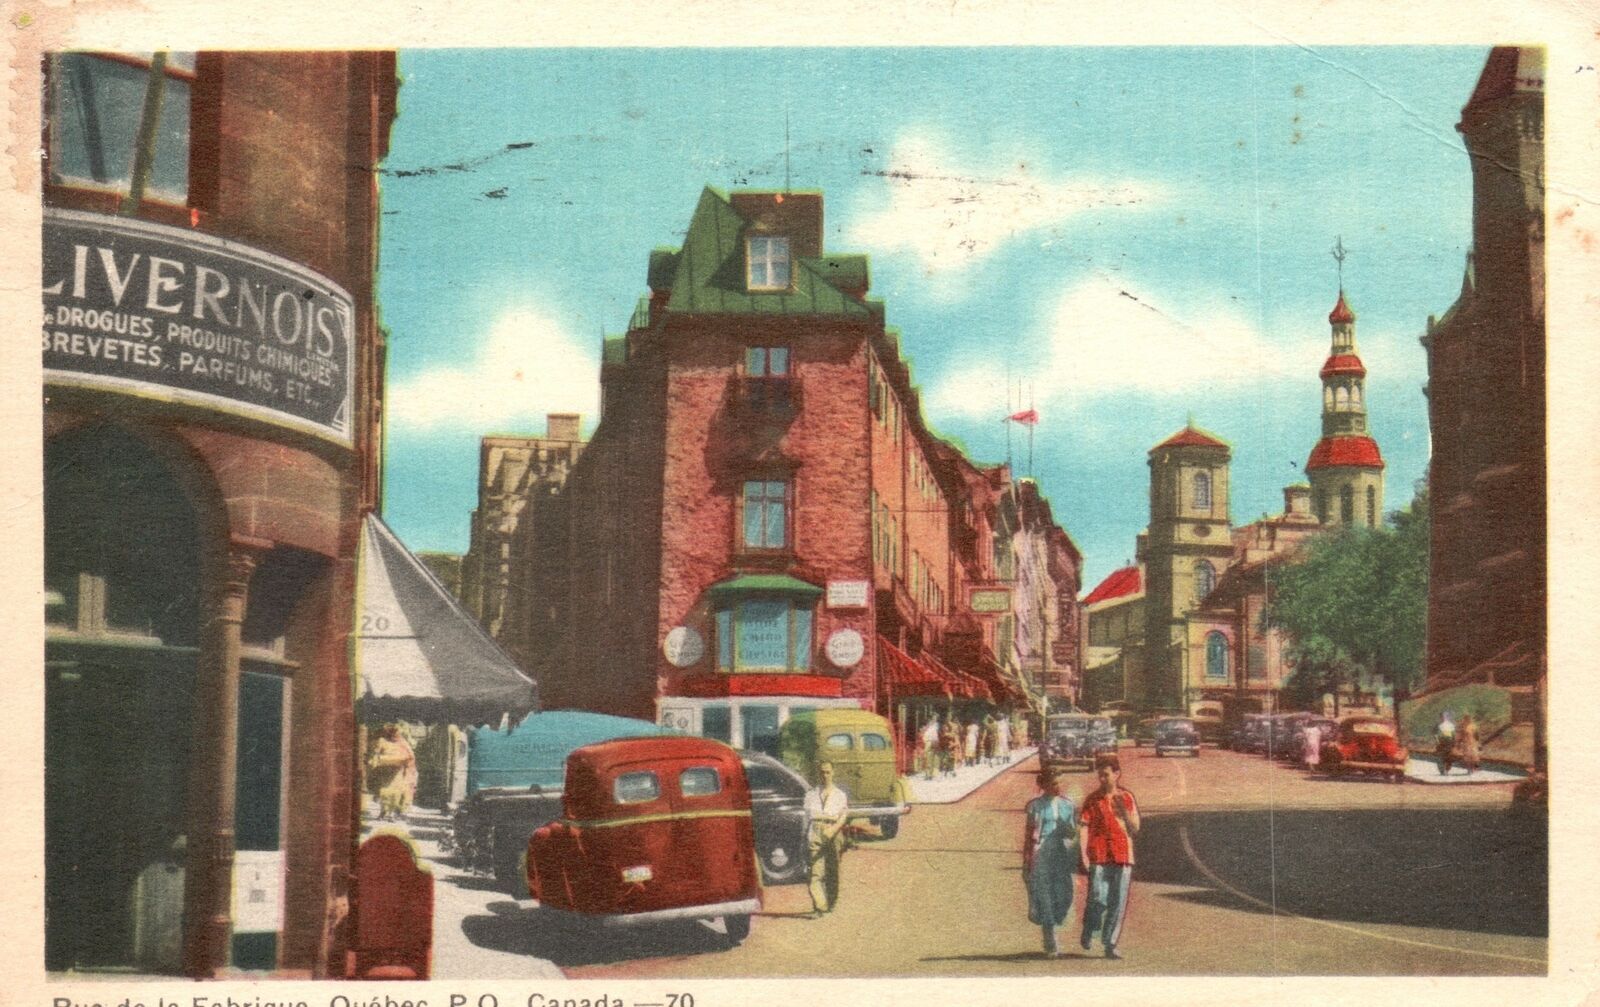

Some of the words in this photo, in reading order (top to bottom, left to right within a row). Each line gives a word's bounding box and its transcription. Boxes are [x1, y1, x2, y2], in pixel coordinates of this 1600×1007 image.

[57, 305, 161, 342] DROGUES,
[167, 322, 251, 361] PRODUITS
[180, 351, 279, 393] PARFUMS,
